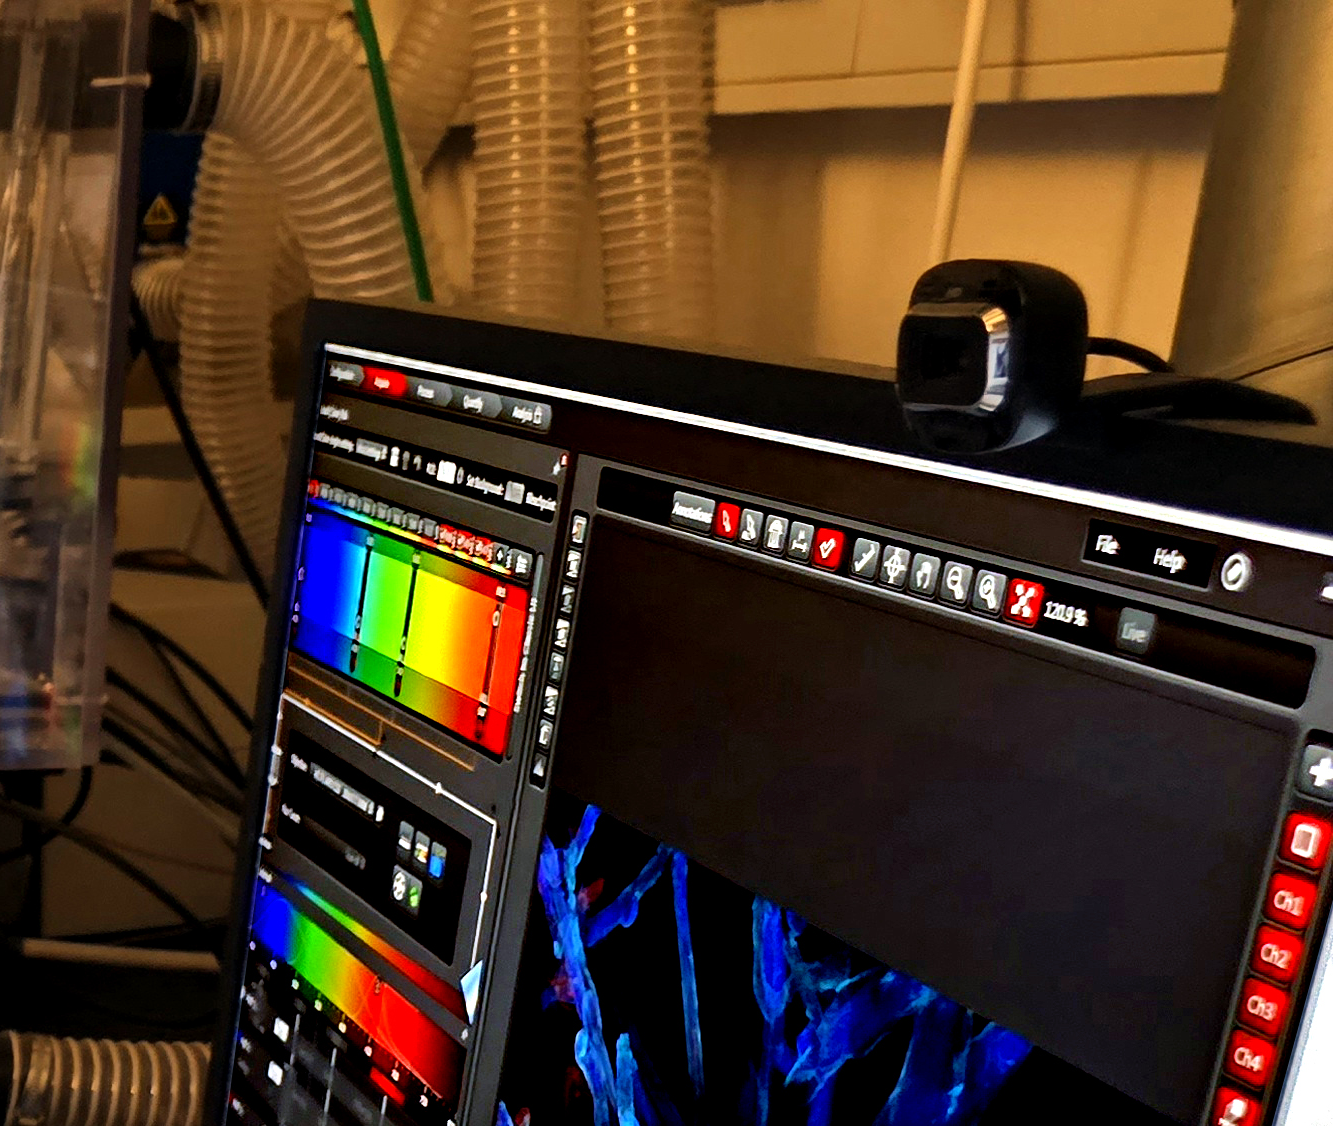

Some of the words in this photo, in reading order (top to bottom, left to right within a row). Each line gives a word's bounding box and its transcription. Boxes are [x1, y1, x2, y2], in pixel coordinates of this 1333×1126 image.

[1095, 534, 1120, 555] File
[1153, 547, 1187, 573] Help
[1273, 890, 1304, 916] Ch1
[1260, 943, 1292, 969] Ch2
[1247, 995, 1278, 1021] Ch3
[1234, 1046, 1264, 1071] Ch4
